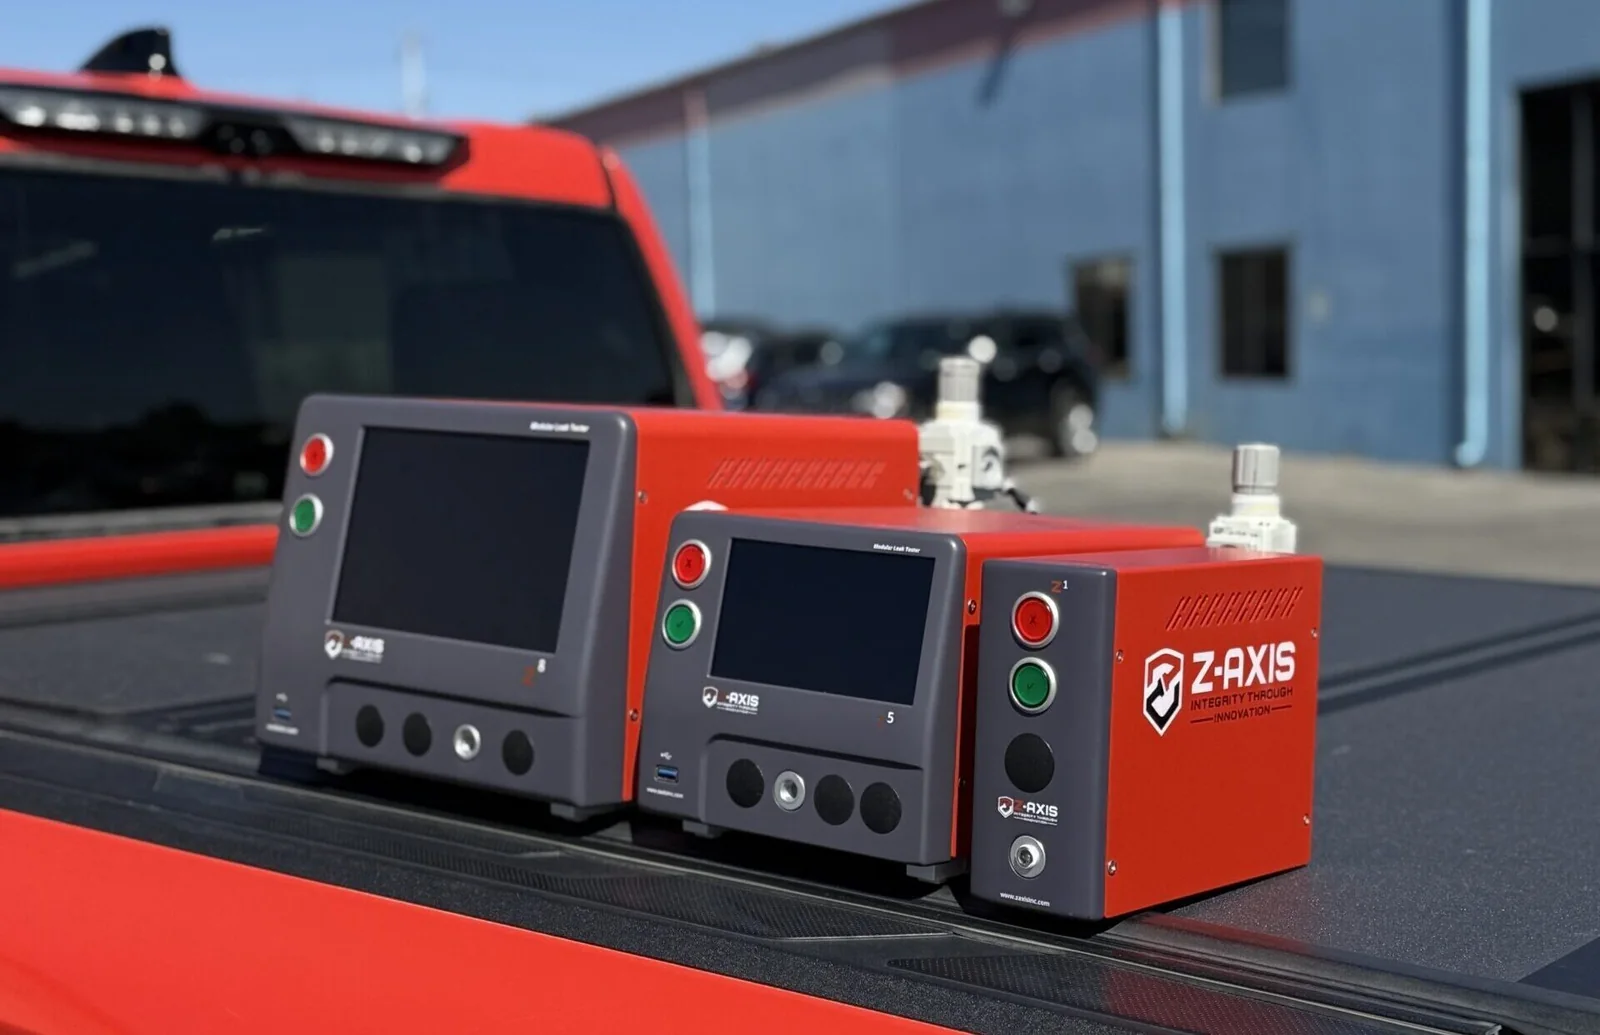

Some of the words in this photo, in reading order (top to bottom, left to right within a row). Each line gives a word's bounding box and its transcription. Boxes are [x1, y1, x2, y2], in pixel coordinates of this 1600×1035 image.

[1191, 640, 1296, 694] Z-AXIS
[1190, 692, 1245, 711] INTEGRITY
[1247, 686, 1294, 703] THROUGH
[1214, 705, 1271, 723] INNOVATION
[1014, 800, 1059, 818] Z-AXIS
